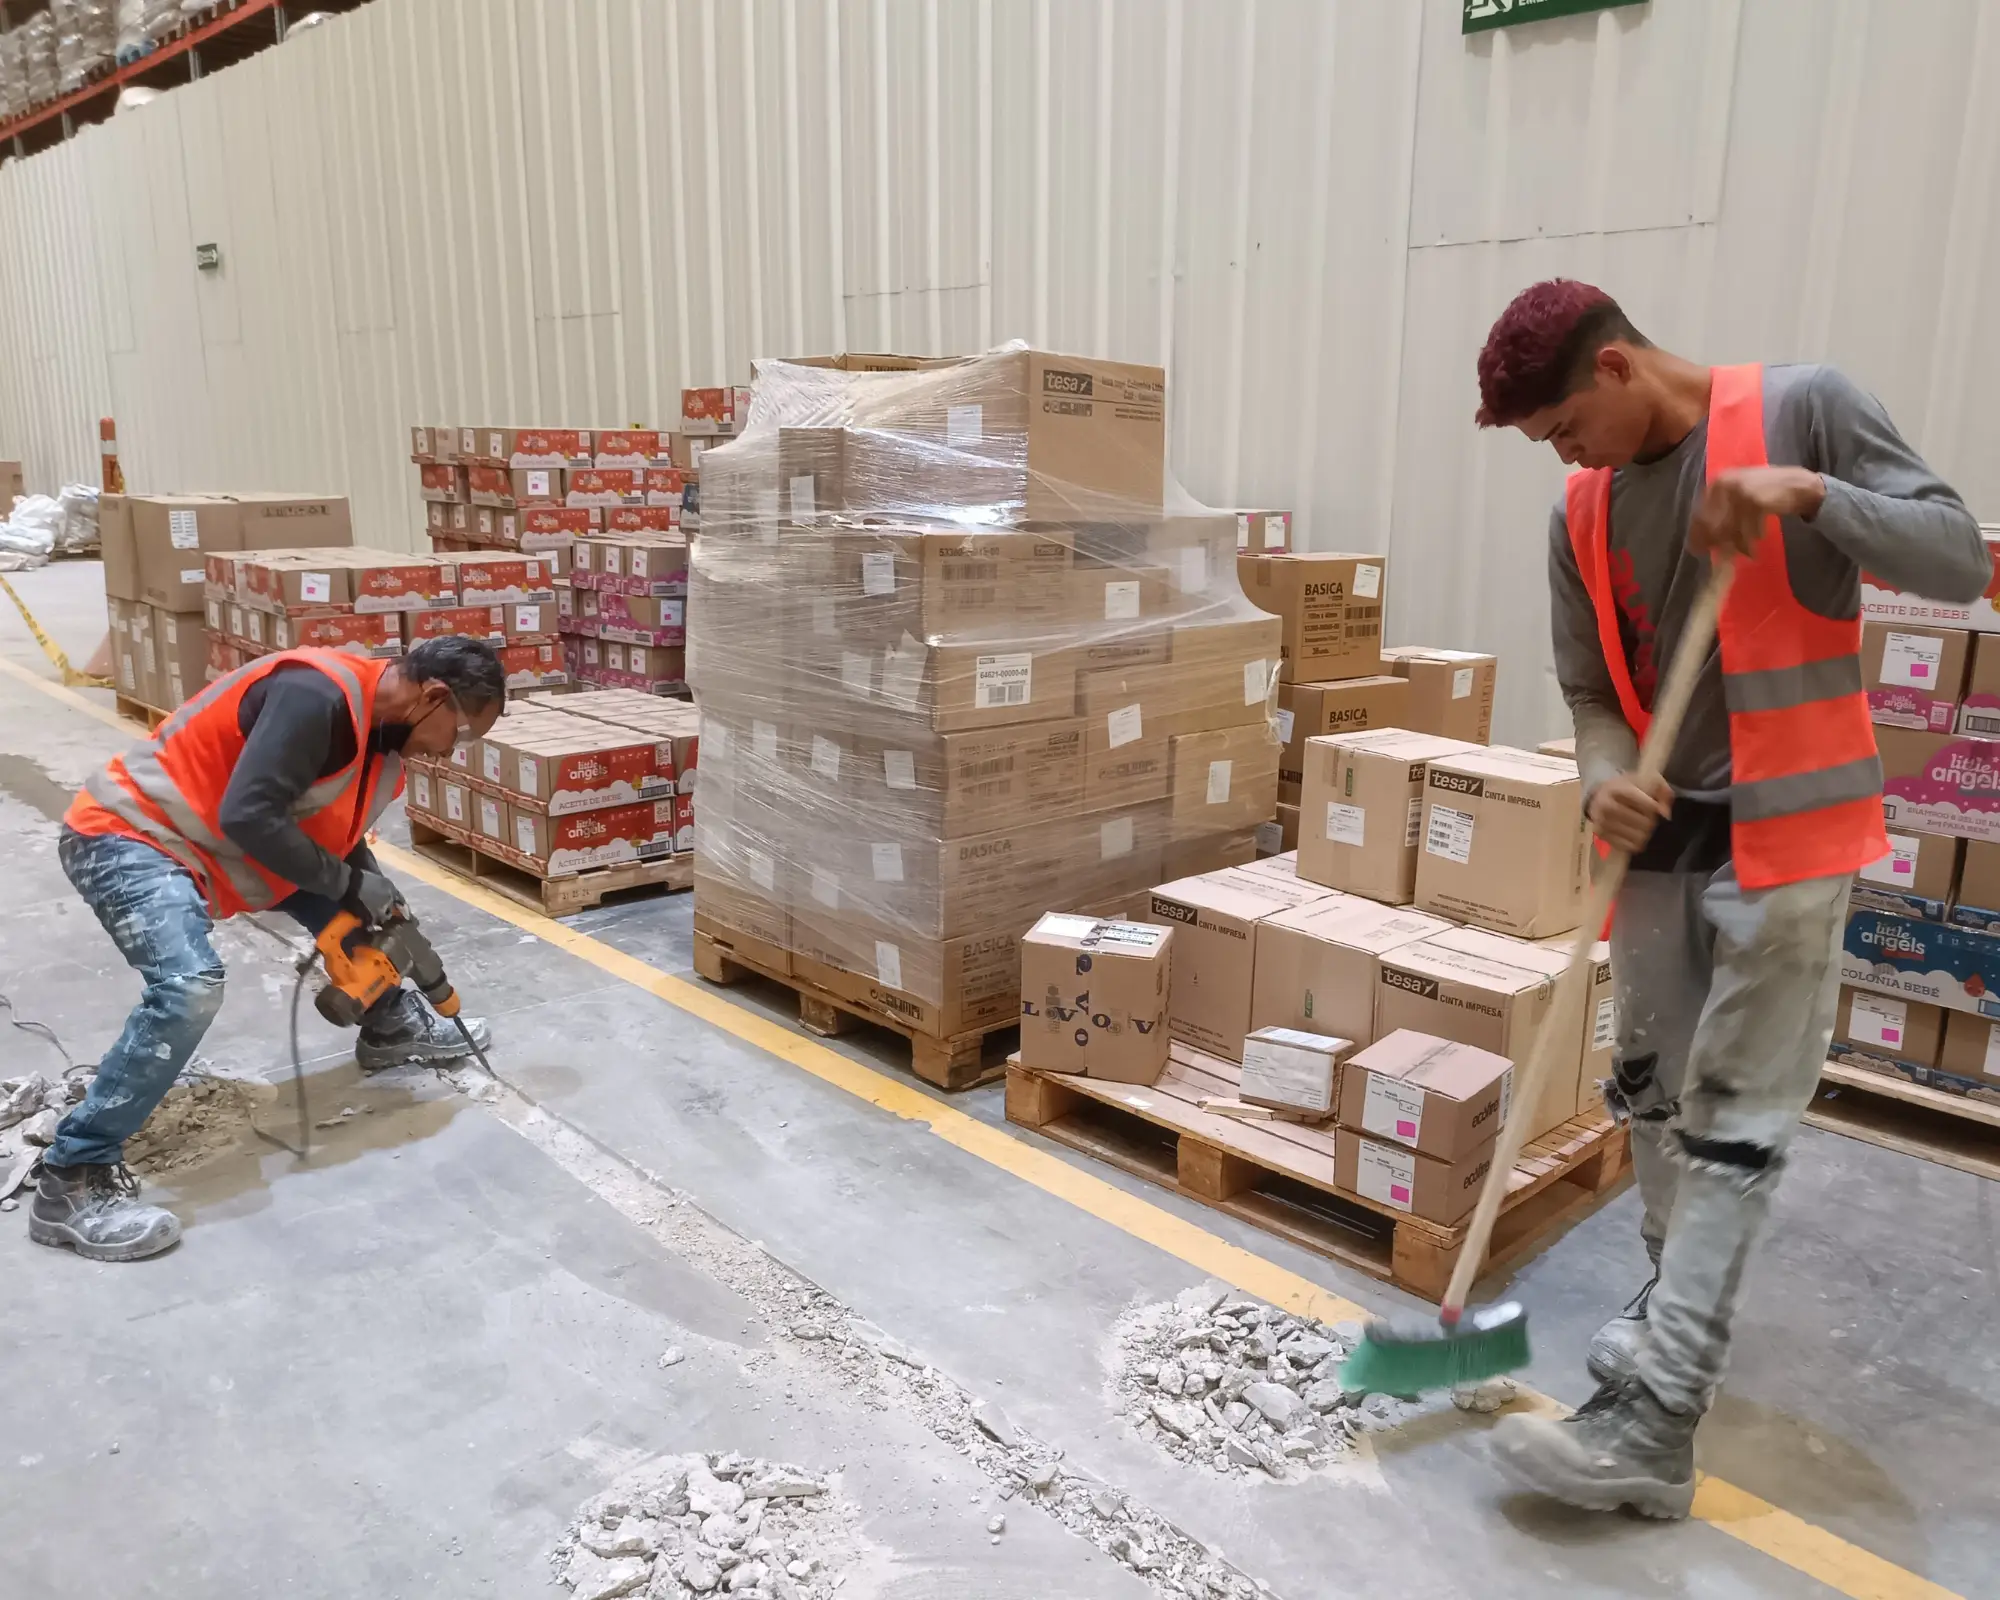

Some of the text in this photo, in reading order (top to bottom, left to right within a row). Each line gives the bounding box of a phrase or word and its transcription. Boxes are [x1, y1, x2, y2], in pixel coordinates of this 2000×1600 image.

[1046, 372, 1079, 391] tesa
[1304, 581, 1343, 596] BASICA
[1860, 603, 1907, 616] ACEITE
[1909, 606, 1928, 617] DE
[1329, 708, 1367, 724] BASICA
[569, 766, 608, 780] angels
[578, 759, 598, 770] little
[1950, 753, 1993, 774] little
[1432, 771, 1467, 792] tesa
[1484, 790, 1541, 810] CINTA IMPRESA
[656, 806, 668, 815] 24
[568, 822, 607, 838] angels
[960, 839, 1012, 860] BASICA
[1153, 899, 1184, 919] tesa
[1199, 920, 1247, 940] CINTA IMPRESA
[1876, 922, 1911, 940] little
[963, 934, 1015, 958] BASICA
[1861, 932, 1926, 954] angels
[1384, 968, 1422, 993] tesa
[1841, 968, 1940, 998] COLONIA BEBÉ
[1439, 994, 1503, 1018] CINTA IMPRESA
